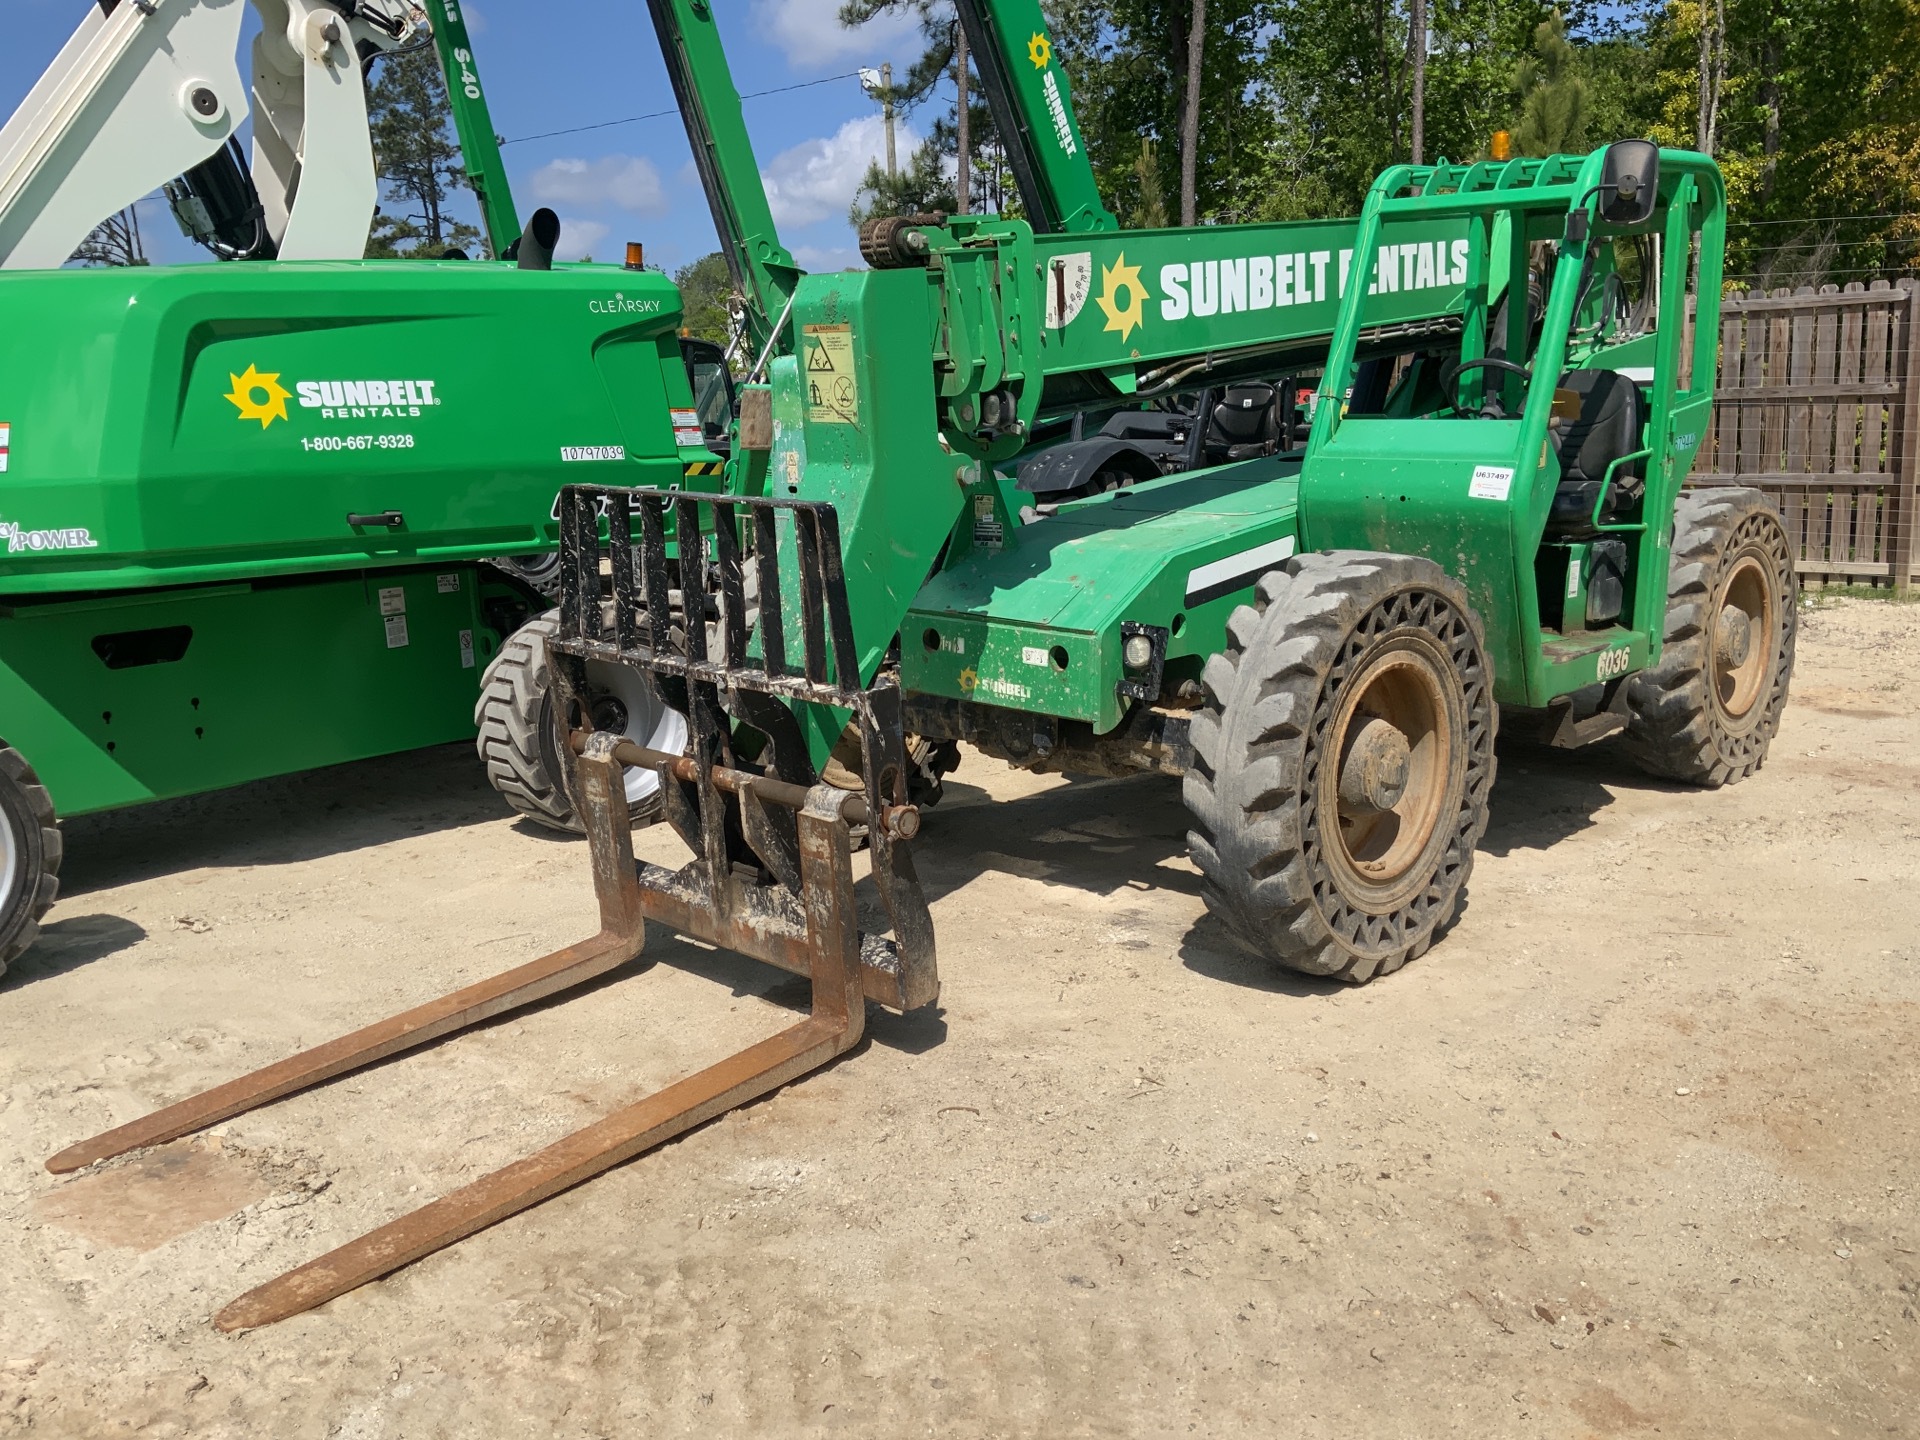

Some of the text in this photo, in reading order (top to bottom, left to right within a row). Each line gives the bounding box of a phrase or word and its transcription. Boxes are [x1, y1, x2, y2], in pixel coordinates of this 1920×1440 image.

[454, 47, 480, 99] S-40
[1043, 70, 1077, 155] SUNBELT
[1160, 239, 1468, 321] SUNBELT NTALS
[588, 300, 662, 314] CLEARSKY
[295, 380, 435, 408] SUNBELT
[321, 406, 421, 419] RENTALS
[300, 434, 415, 451] 1-800-667-9328
[562, 445, 625, 460] 10797039
[1475, 470, 1510, 481] U637497
[1596, 646, 1631, 681] 6036
[981, 676, 1032, 699] SUNBELT
